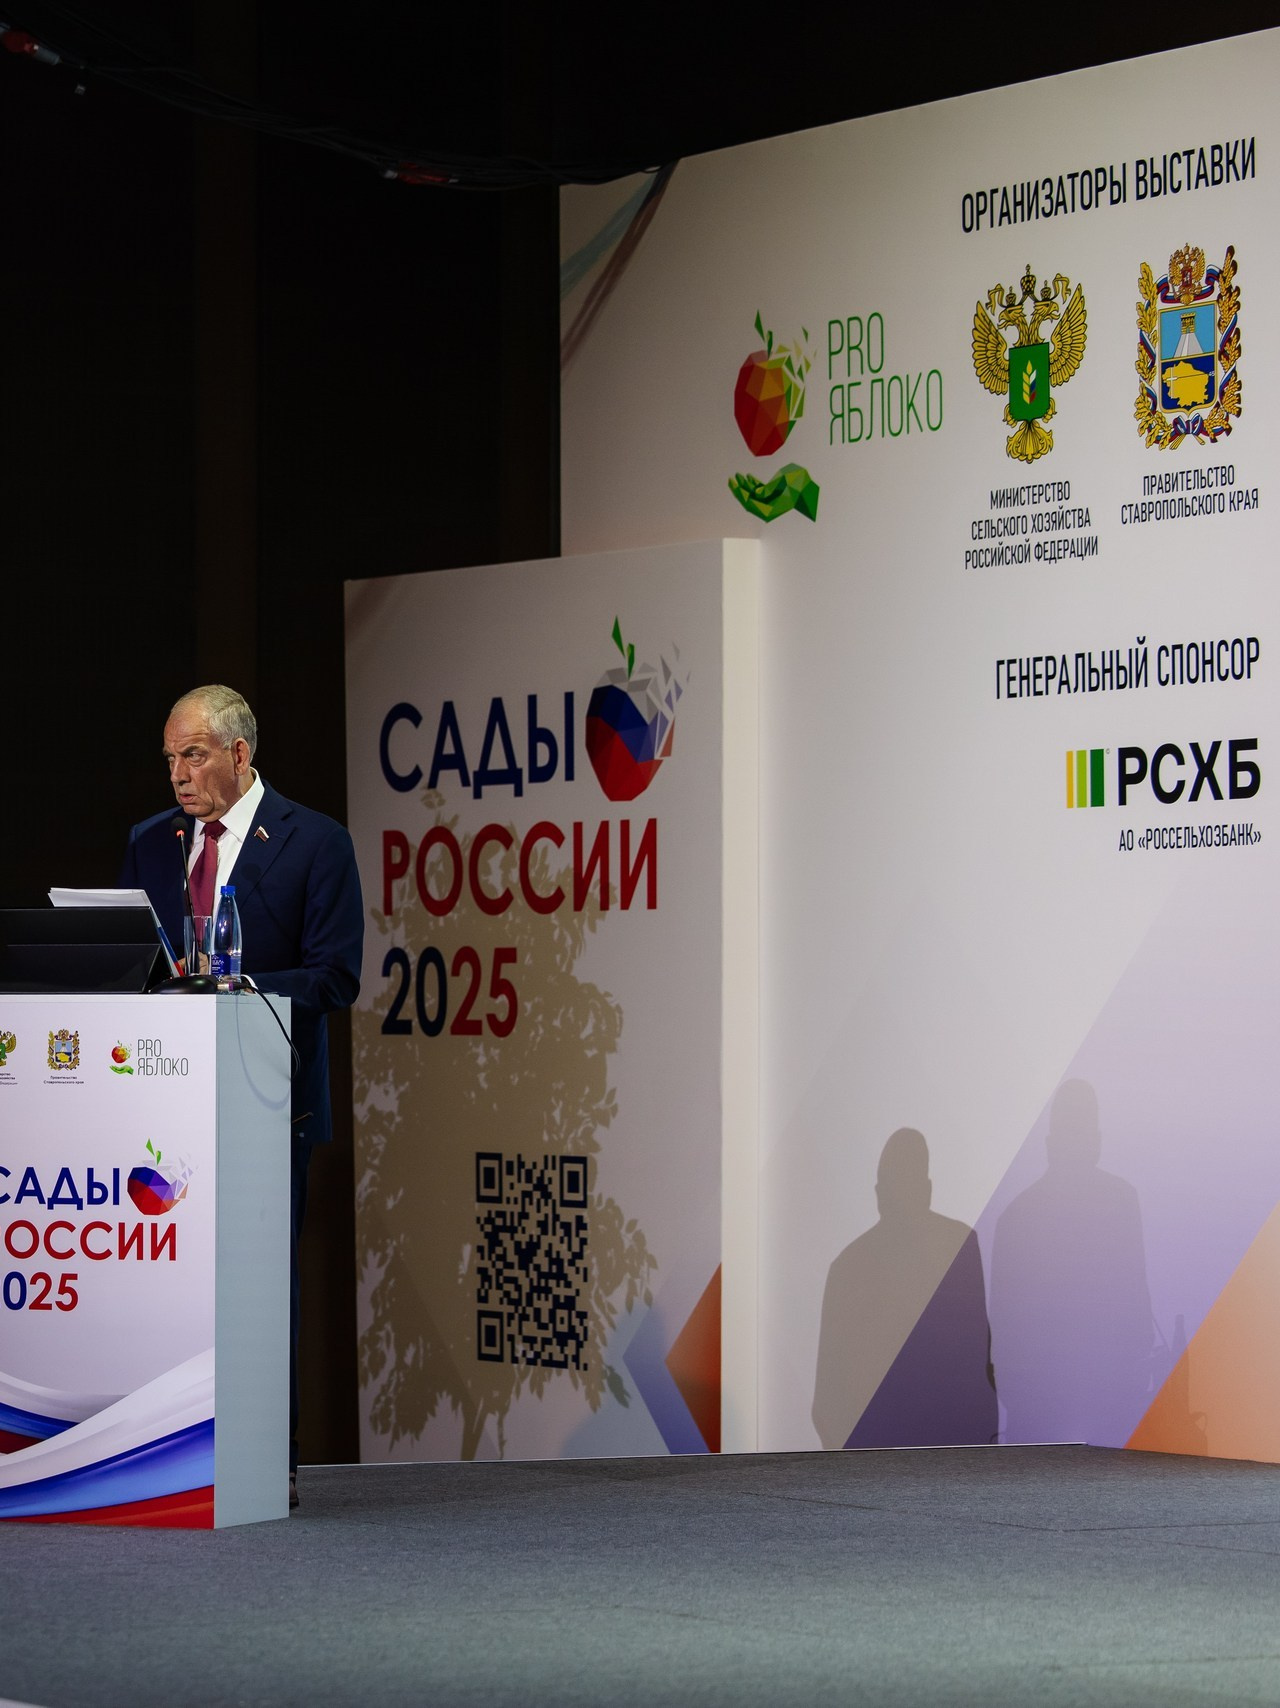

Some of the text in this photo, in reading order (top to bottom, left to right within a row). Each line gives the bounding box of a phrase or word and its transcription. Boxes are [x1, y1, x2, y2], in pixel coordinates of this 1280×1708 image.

[961, 136, 1256, 234] ОРГАНИЗАТОРЫ ВЫСТАВКИ
[827, 311, 885, 381] PRO
[828, 368, 944, 446] ЯБЛОКО
[989, 480, 1071, 510] МИНИСТЕРСТВО
[1142, 464, 1235, 496] ПРАВИТЕЛЬСТВО
[971, 504, 1092, 541] СЕЛЬСКОГО ХОЗЯЙСТВА
[1121, 487, 1259, 525] СТАВРОПОЛЬСКОГО КРАЯ
[964, 535, 1099, 570] РОССИЙСКОЙ ФЕДЕРАЦИИ
[996, 636, 1261, 700] ГЕНЕРАЛЬНЫЙ СПОНСОР
[378, 691, 575, 800] САДЫ
[1117, 737, 1261, 807] РСХБ
[1118, 822, 1262, 852] АО «РОССЕЛЬХОЗБАНК»
[382, 818, 658, 917] РОССИИ
[381, 946, 519, 1038] 2025
[136, 1038, 162, 1058] PRO
[136, 1057, 189, 1077] ЯБЛОКО
